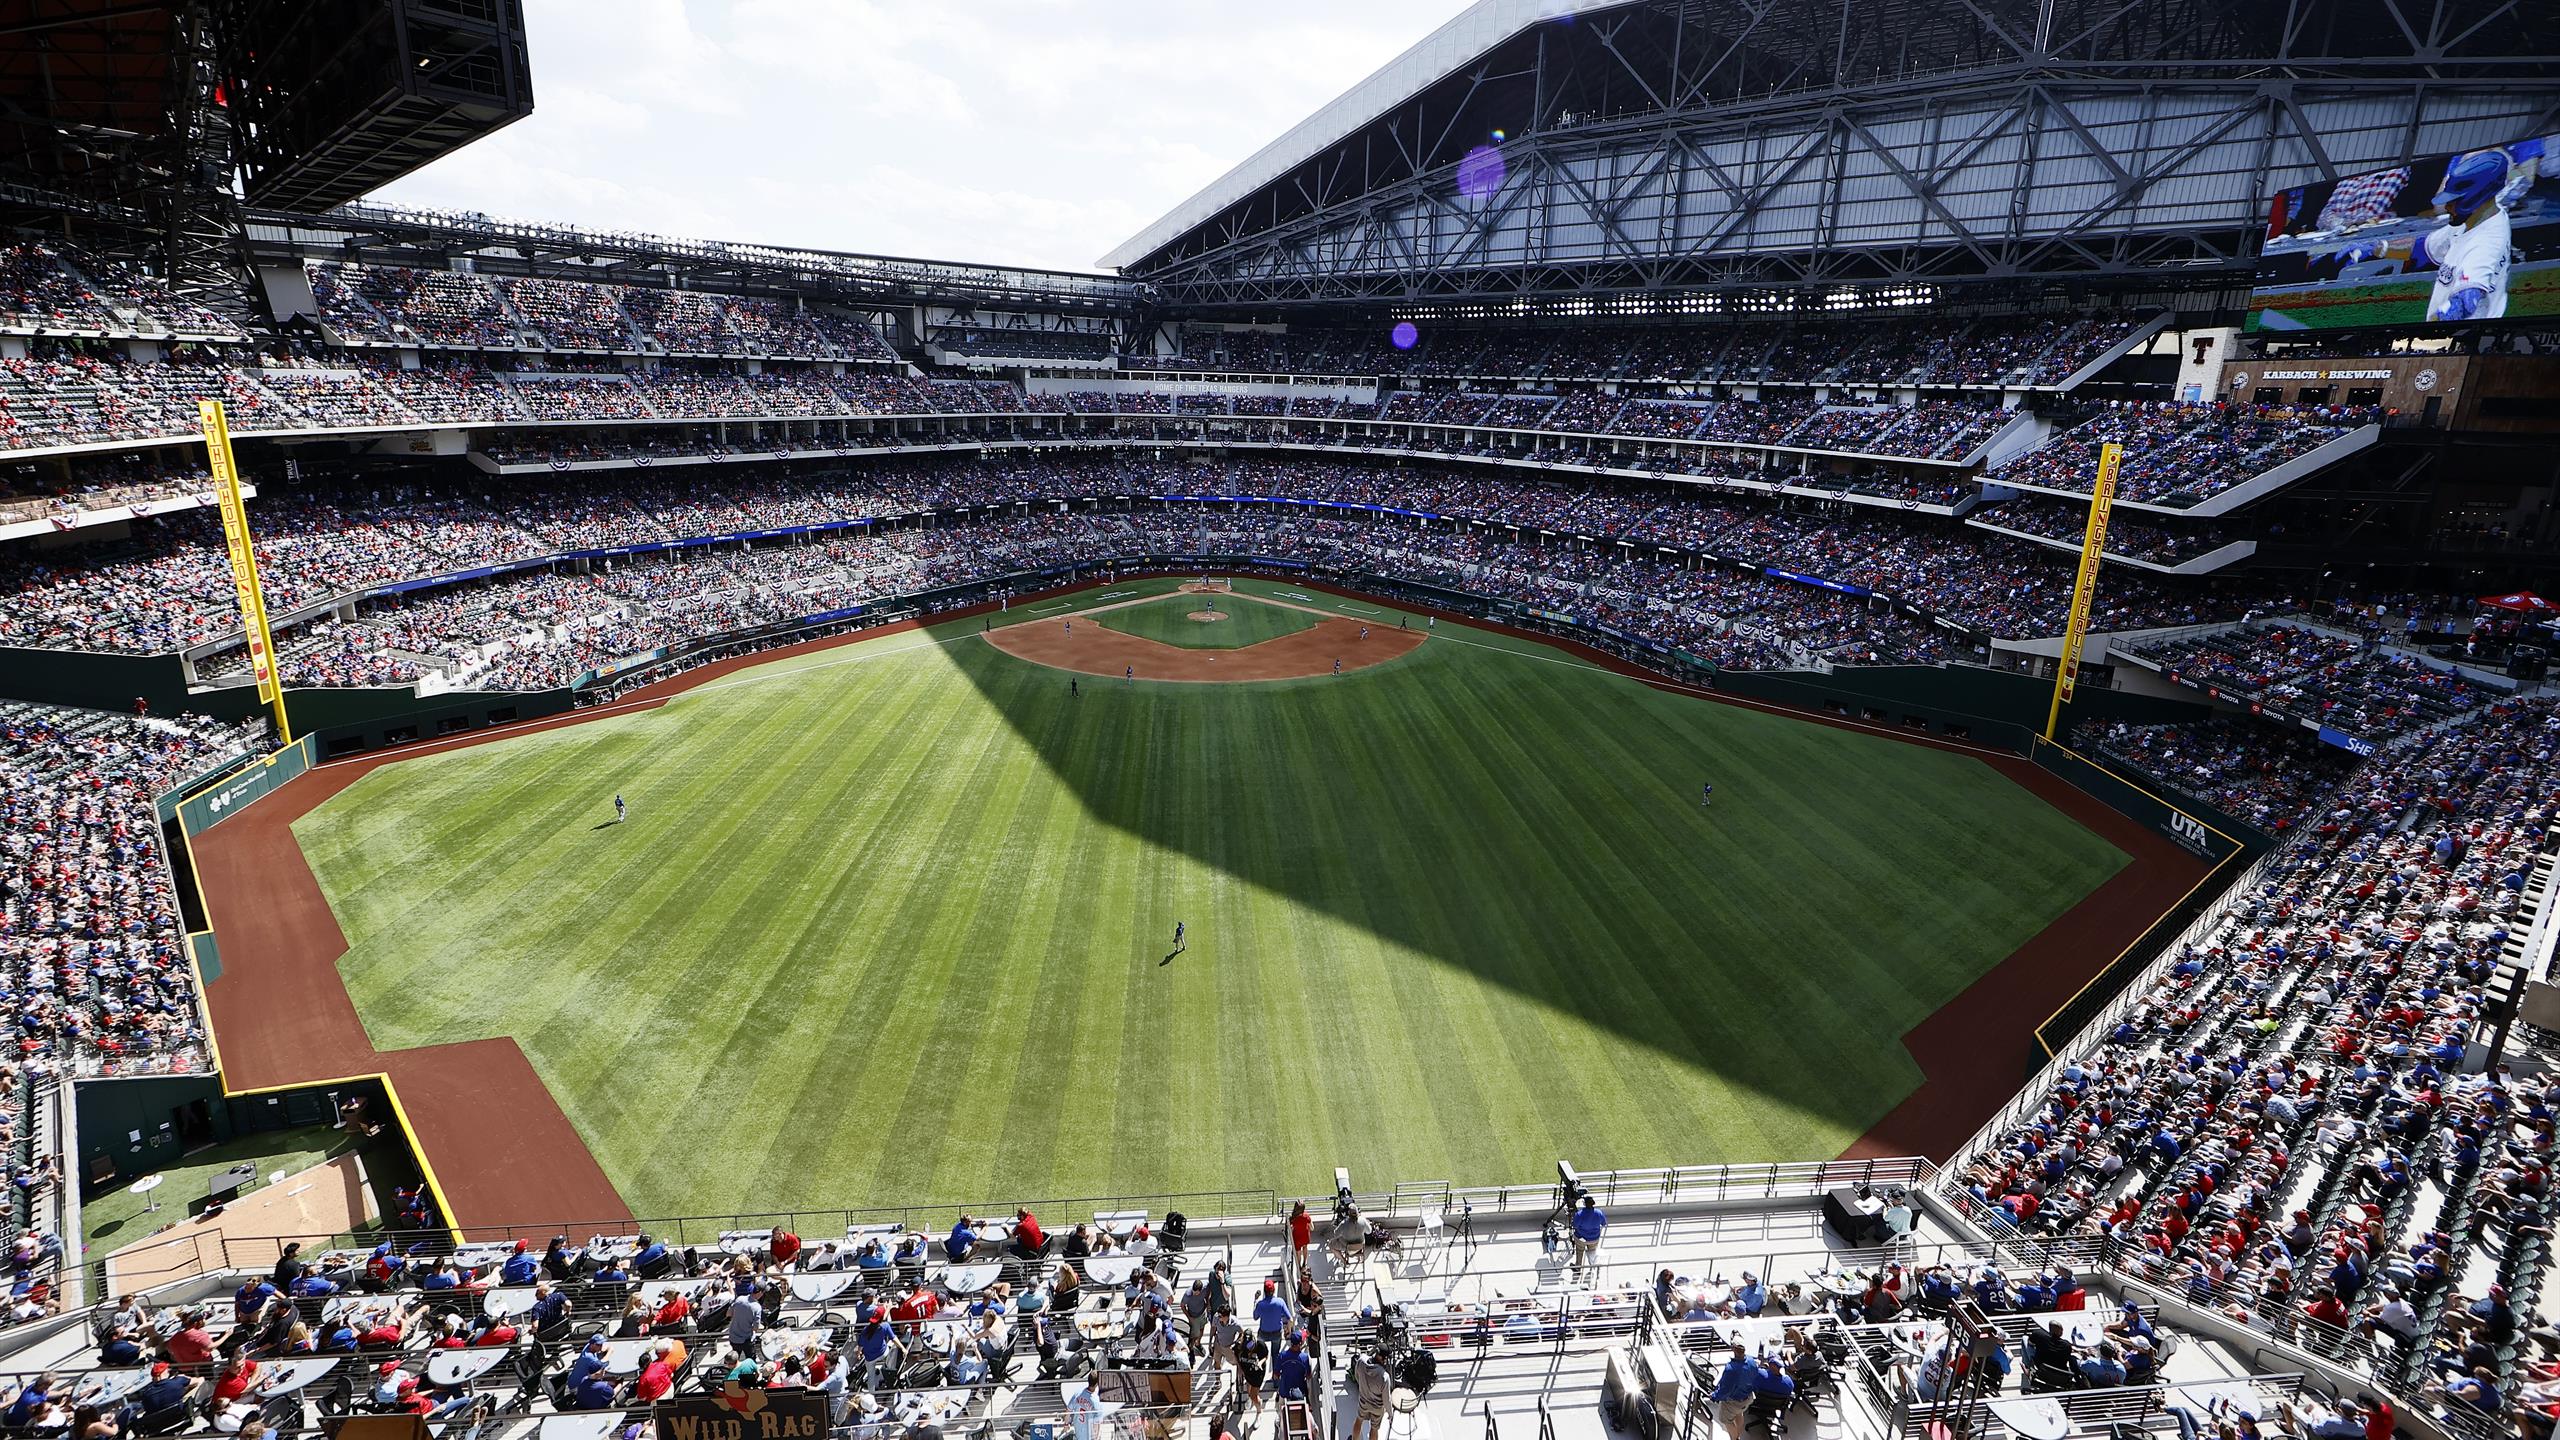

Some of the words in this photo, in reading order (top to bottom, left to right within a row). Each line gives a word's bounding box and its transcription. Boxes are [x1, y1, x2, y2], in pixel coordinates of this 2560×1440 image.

[2192, 337, 2214, 365] T
[2262, 370, 2318, 380] KARBACH
[2328, 370, 2392, 380] BREWING
[1154, 383, 1174, 392] HOME
[1175, 384, 1183, 392] OF
[1185, 384, 1197, 392] THE
[1199, 384, 1218, 392] TEXAS
[1219, 385, 1248, 393] RANGERS
[209, 430, 225, 479] THE
[284, 459, 295, 480] TRULY
[222, 491, 239, 538] HOT
[2093, 468, 2115, 541] BRING
[2085, 545, 2099, 588] THE
[2072, 591, 2091, 648] HEAT
[2180, 678, 2198, 689] TOYOTA
[2218, 692, 2239, 705] TOYOTA
[2262, 708, 2285, 722] TOYOTA
[2170, 811, 2207, 847] UTA
[2176, 839, 2202, 857] ARLINGTON
[2194, 842, 2202, 850] OF
[2201, 847, 2216, 858] TEXAS
[1990, 1290, 2005, 1303] 29
[1951, 1317, 1970, 1347] 135
[669, 1415, 742, 1440] WILD
[759, 1411, 816, 1438] RAG
